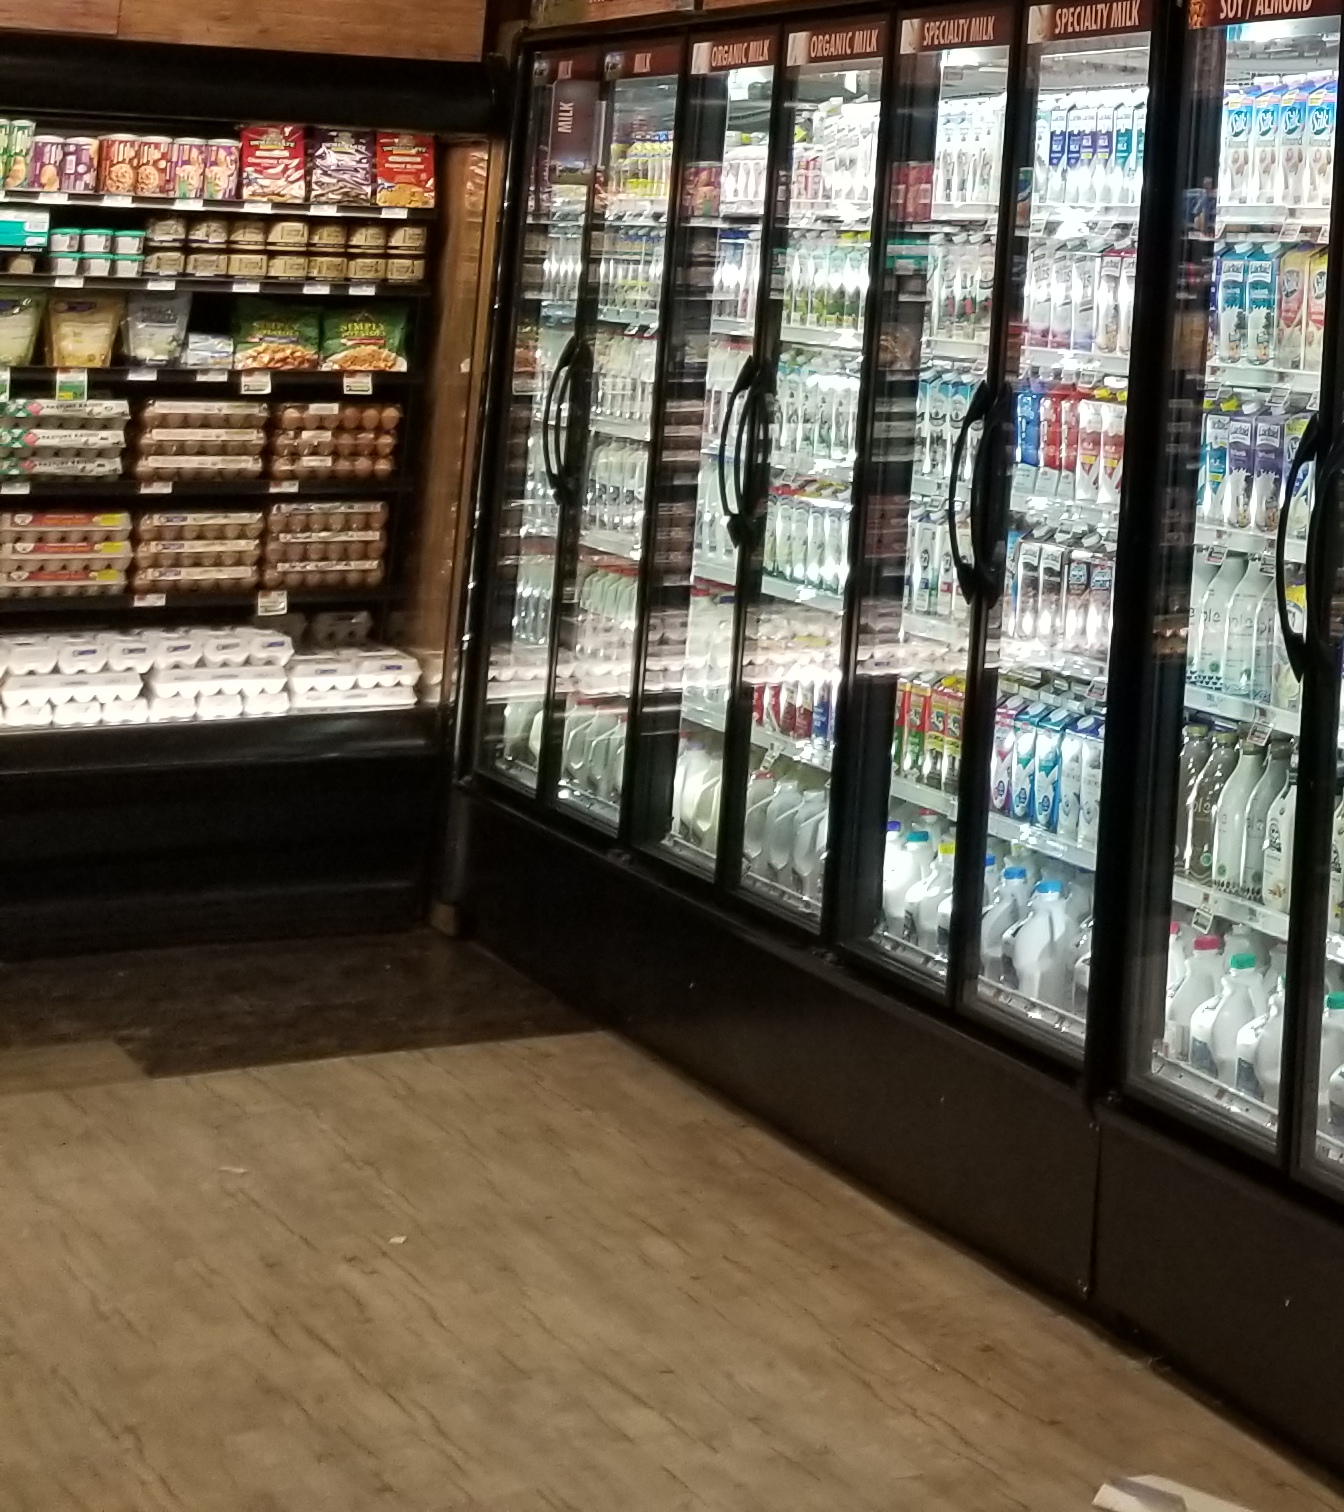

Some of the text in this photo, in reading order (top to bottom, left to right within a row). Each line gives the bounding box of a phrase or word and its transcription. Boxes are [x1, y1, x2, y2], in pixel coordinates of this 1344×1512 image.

[923, 16, 994, 45] SPECIALTY MILK
[1054, 0, 1140, 34] SPECIALTY MILK
[711, 39, 770, 66] ORGANIC MILK
[810, 28, 879, 58] ORGANIC MILK
[633, 53, 651, 73] MILK
[558, 101, 574, 134] MILK
